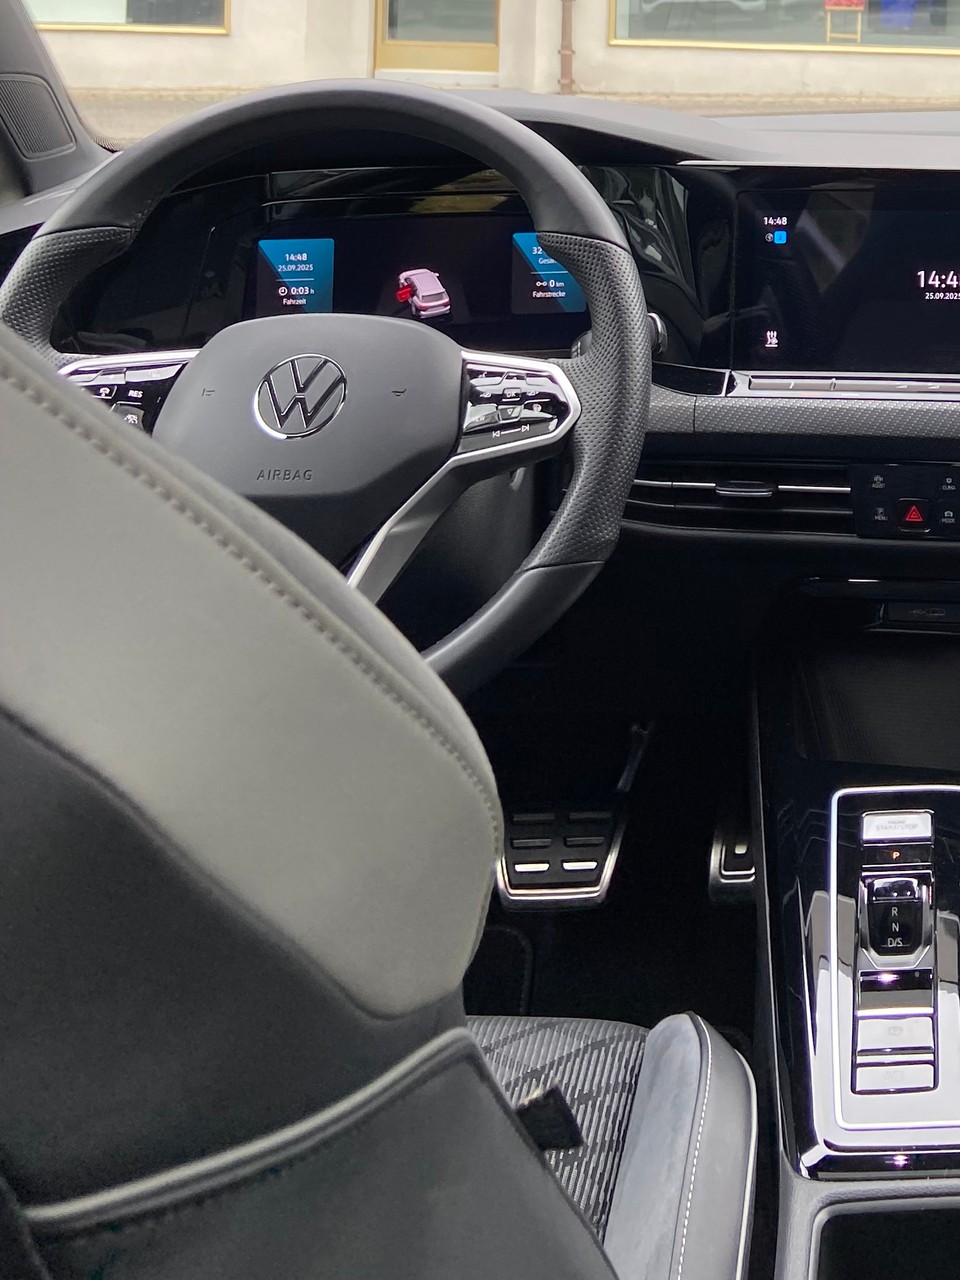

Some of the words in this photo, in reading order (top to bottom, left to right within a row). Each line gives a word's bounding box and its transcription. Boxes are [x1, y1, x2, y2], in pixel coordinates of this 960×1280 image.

[763, 216, 788, 225] 14:48
[285, 252, 307, 262] 14:48
[277, 264, 314, 272] 25.09.2025
[549, 279, 555, 287] 0
[290, 286, 310, 295] 0:03
[532, 290, 566, 298] Fahrstrecke
[282, 298, 307, 306] Fahrzeit
[128, 389, 144, 398] RES
[252, 352, 348, 442] VW
[256, 469, 313, 481] AIRBAG
[893, 851, 900, 859] P
[891, 906, 899, 917] R
[892, 922, 900, 932] N
[887, 937, 903, 947] D/S
